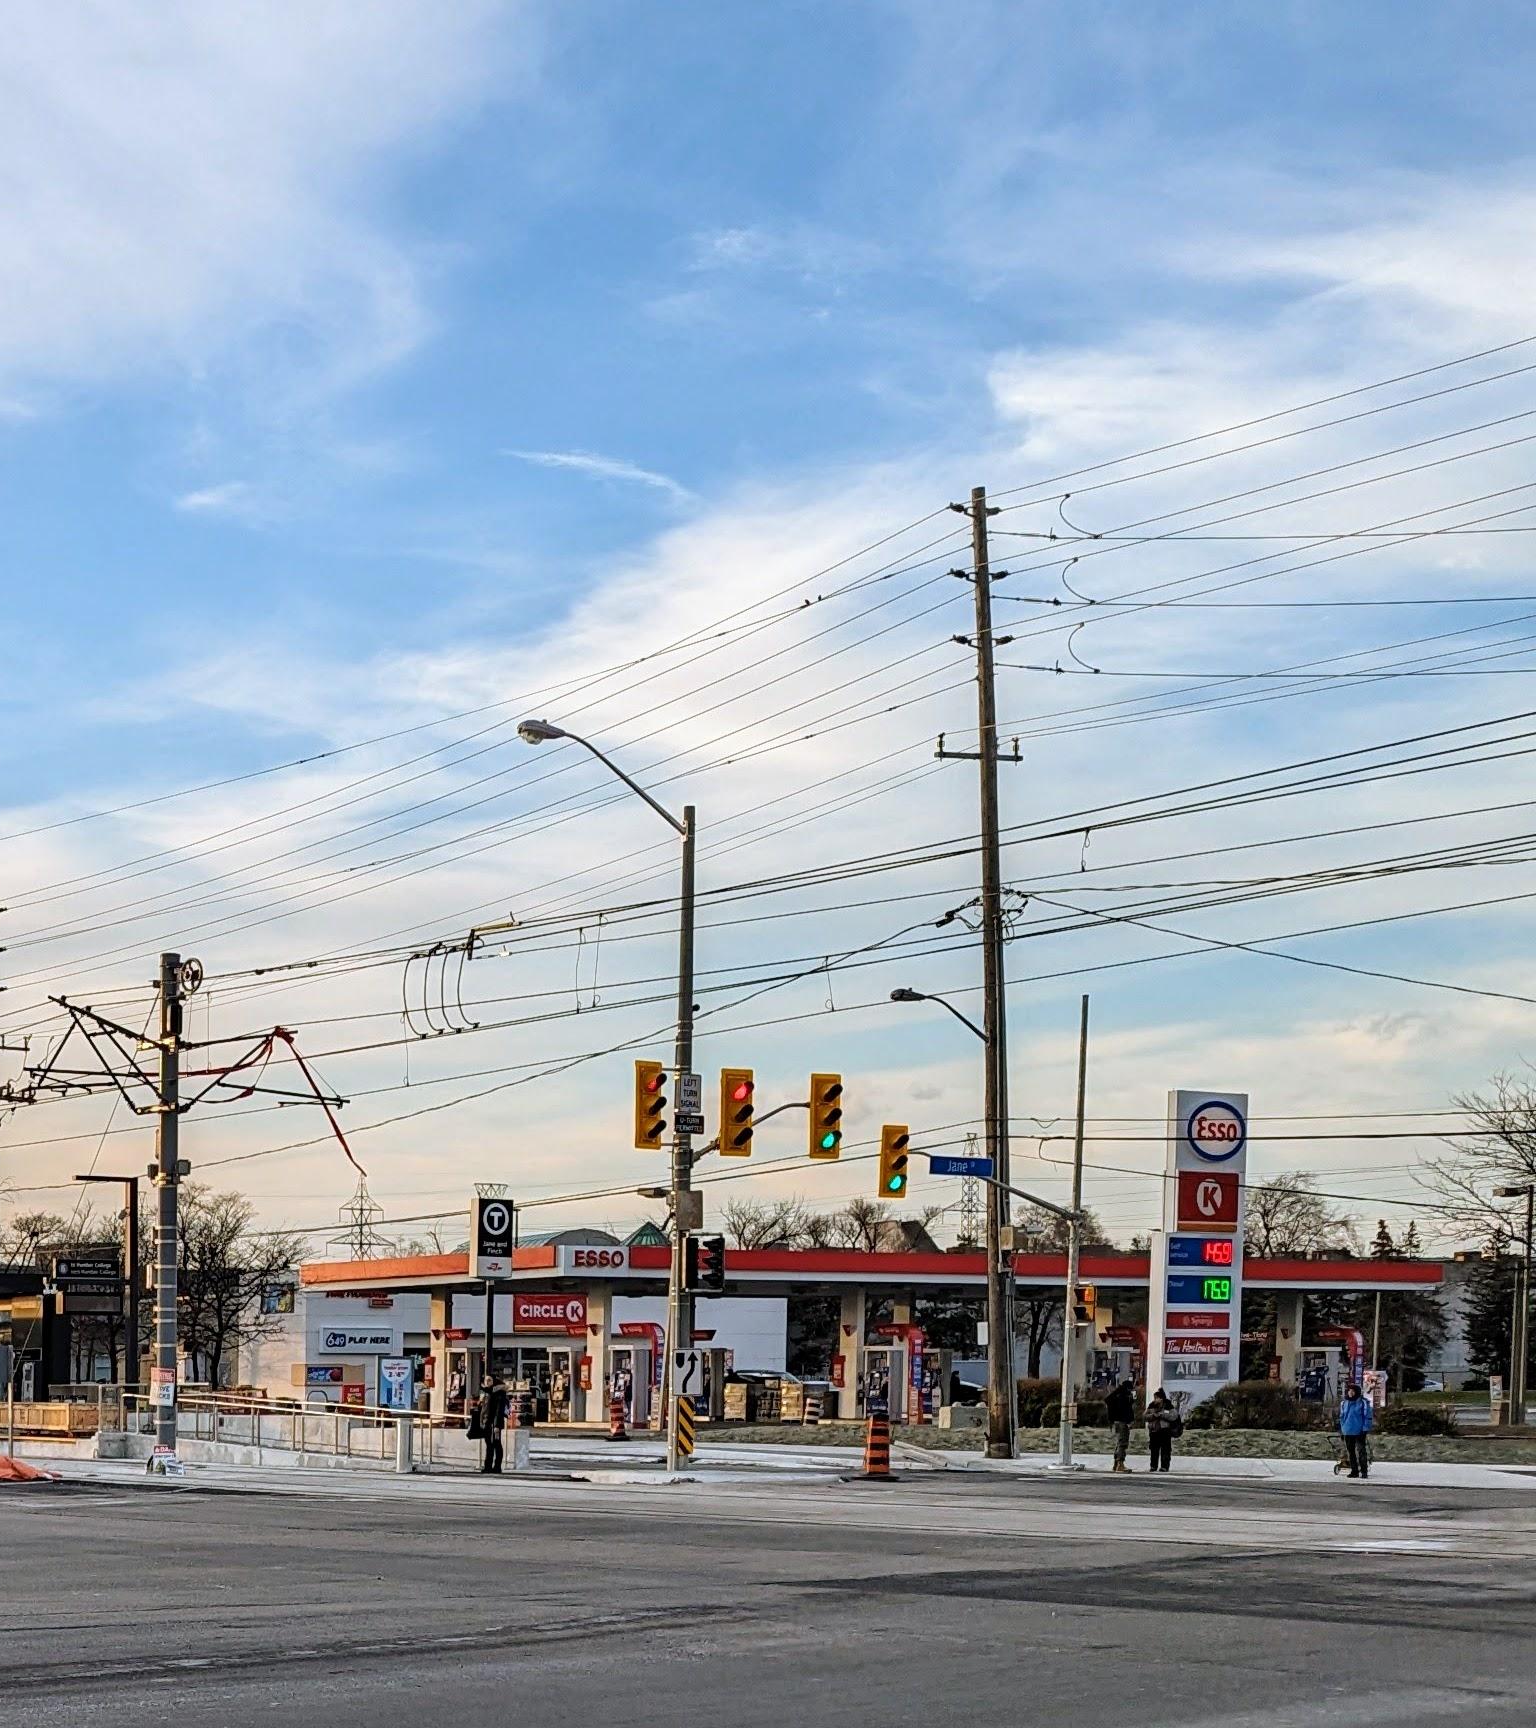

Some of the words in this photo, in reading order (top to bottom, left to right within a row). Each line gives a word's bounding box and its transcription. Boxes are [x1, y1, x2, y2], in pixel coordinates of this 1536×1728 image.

[1197, 1116, 1238, 1142] Esso
[947, 1160, 969, 1173] Jane
[573, 1249, 625, 1268] ESSO
[519, 1304, 564, 1318] CIRCLE
[1176, 1361, 1200, 1375] ATM
